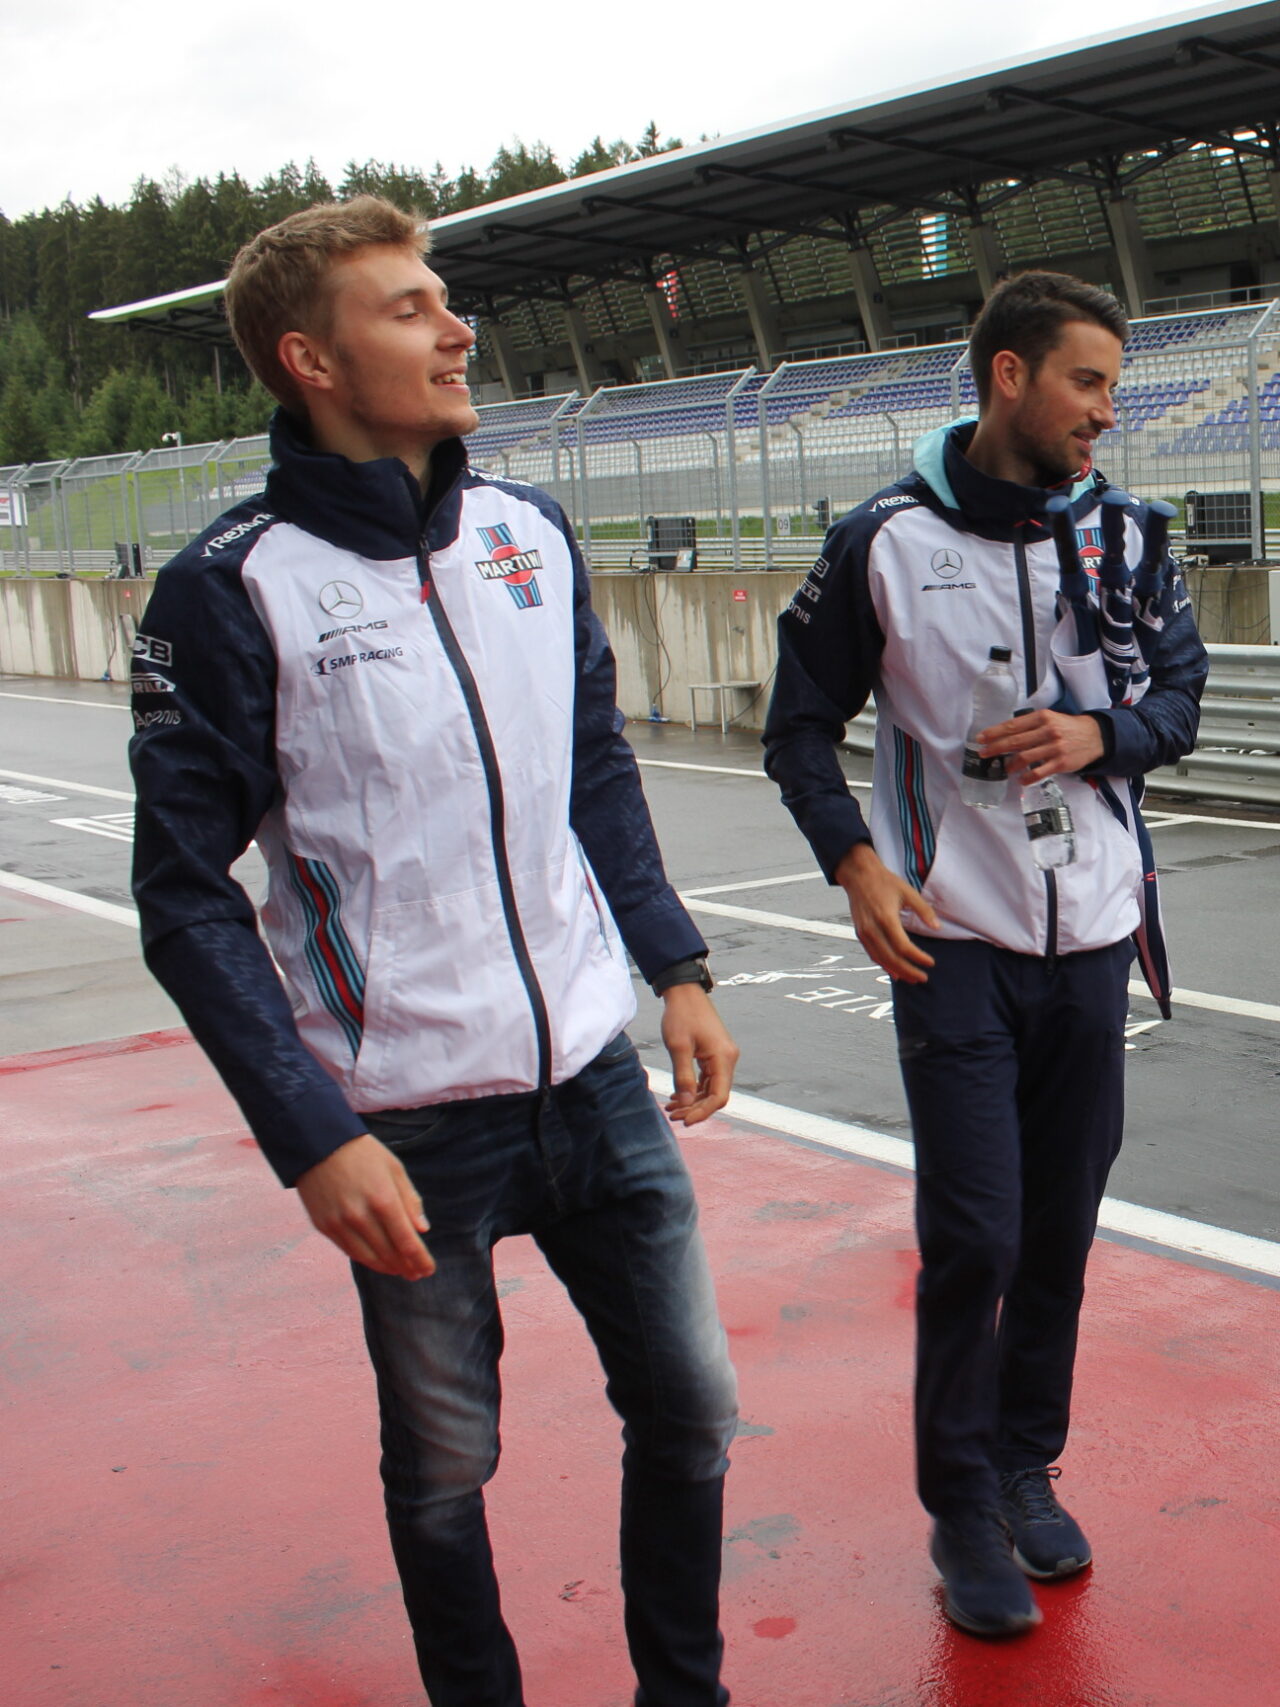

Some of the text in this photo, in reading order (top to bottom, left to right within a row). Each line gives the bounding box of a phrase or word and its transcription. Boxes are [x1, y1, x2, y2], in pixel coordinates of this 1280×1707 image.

[477, 550, 542, 579] MARTINI
[939, 582, 977, 591] AMG
[342, 620, 389, 635] AMG
[329, 647, 403, 670] SMP RACING
